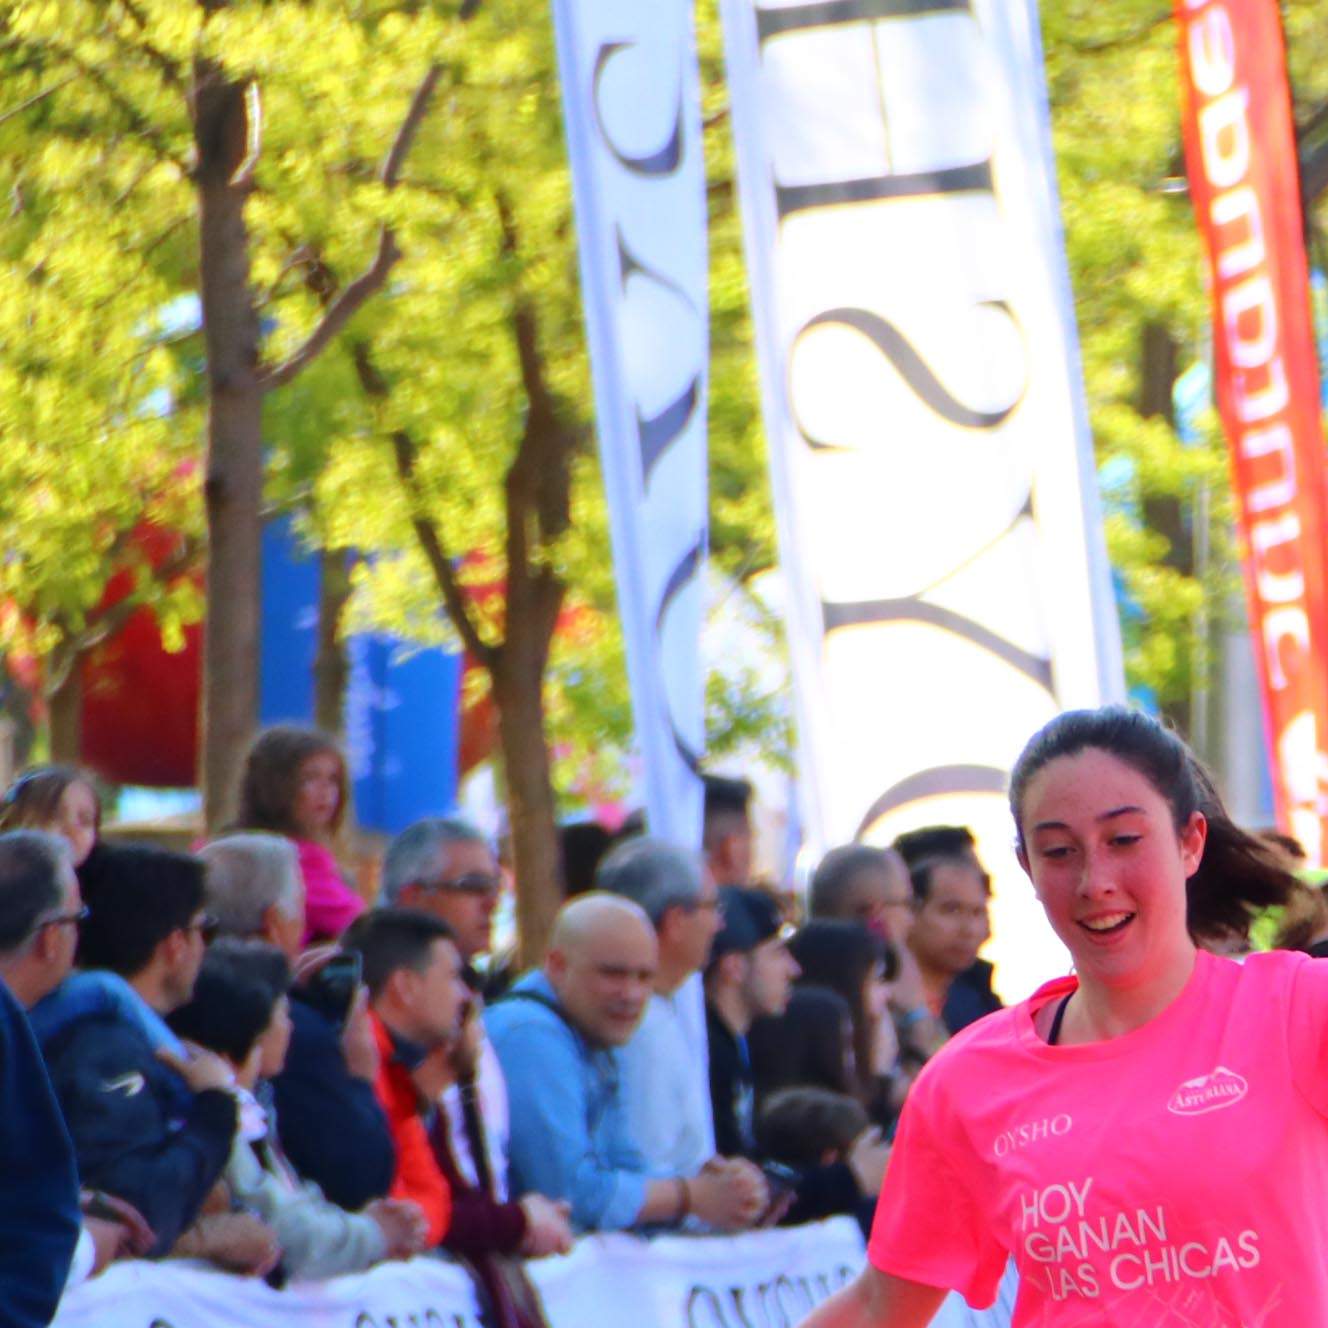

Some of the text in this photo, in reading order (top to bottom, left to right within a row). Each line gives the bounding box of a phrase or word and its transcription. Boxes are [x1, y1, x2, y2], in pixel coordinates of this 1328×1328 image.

[993, 1113, 1073, 1157] OYSHO
[1020, 1177, 1093, 1232] HOY
[1024, 1206, 1167, 1262] GANAN
[1046, 1230, 1261, 1301] LAS CHICAS
